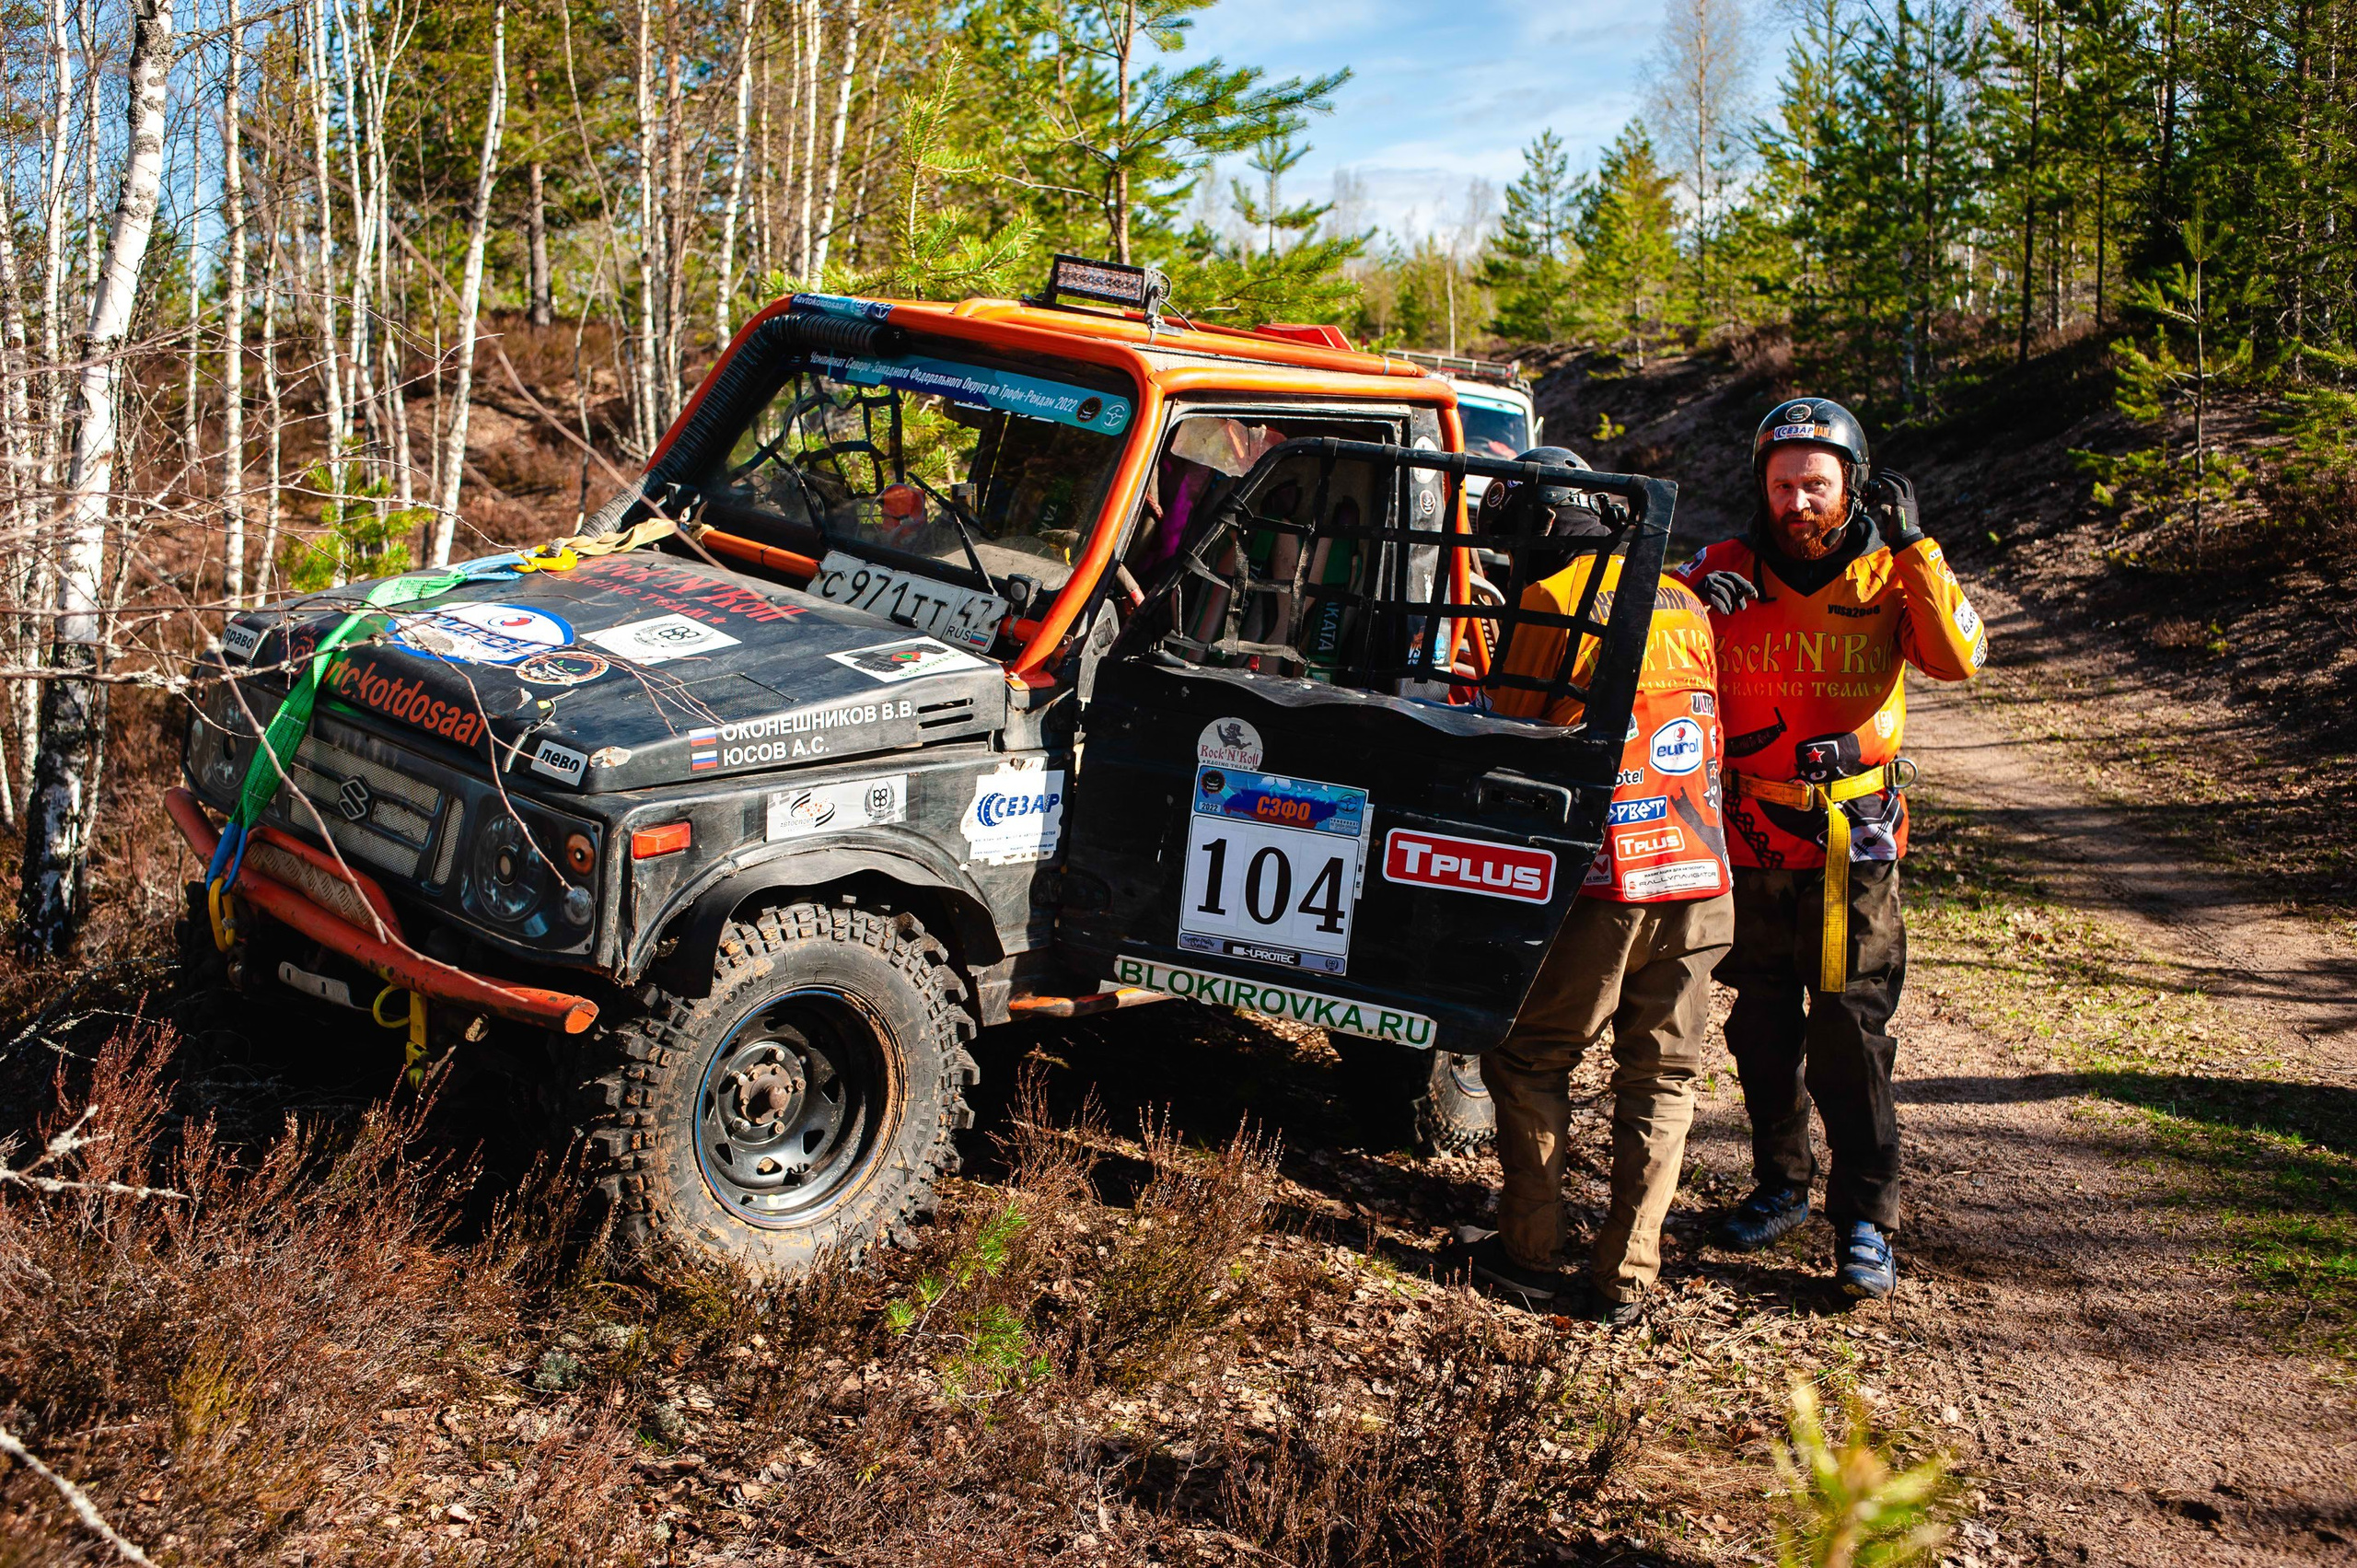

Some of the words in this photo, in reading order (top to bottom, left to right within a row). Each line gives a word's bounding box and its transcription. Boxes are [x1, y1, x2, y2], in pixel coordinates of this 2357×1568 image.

[793, 294, 848, 310] #avtokotdosaaf
[809, 351, 846, 367] Чемпионат
[910, 366, 962, 389] Федерального
[961, 377, 988, 394] Округа
[988, 385, 999, 396] по
[999, 384, 1055, 408] Трофи-Рейдам
[1053, 396, 1078, 412] 2022
[946, 625, 970, 641] RUS
[1318, 600, 1340, 651] KATA
[223, 628, 254, 649] право
[1733, 681, 1804, 698] RACING
[1811, 680, 1870, 698] TEAM
[1692, 694, 1714, 715] ULTR
[722, 705, 877, 742] ОКОНЕШНИКОВ
[881, 700, 917, 721] В.В.
[723, 741, 787, 766] ЮСОВ
[792, 737, 830, 757] А.С.
[1200, 744, 1260, 765] Rock'N'Roll
[1657, 738, 1700, 758] eurol
[994, 794, 1060, 818] СЕЗАР
[1202, 802, 1218, 812] 2022
[1257, 796, 1311, 821] СЗФО
[1620, 834, 1679, 854] TPLUS
[1397, 840, 1542, 891] TPLUS
[1197, 837, 1346, 935] 104
[1243, 947, 1295, 965] SUPROTEC
[1120, 961, 1431, 1045] BLOKIROVKA.RU
